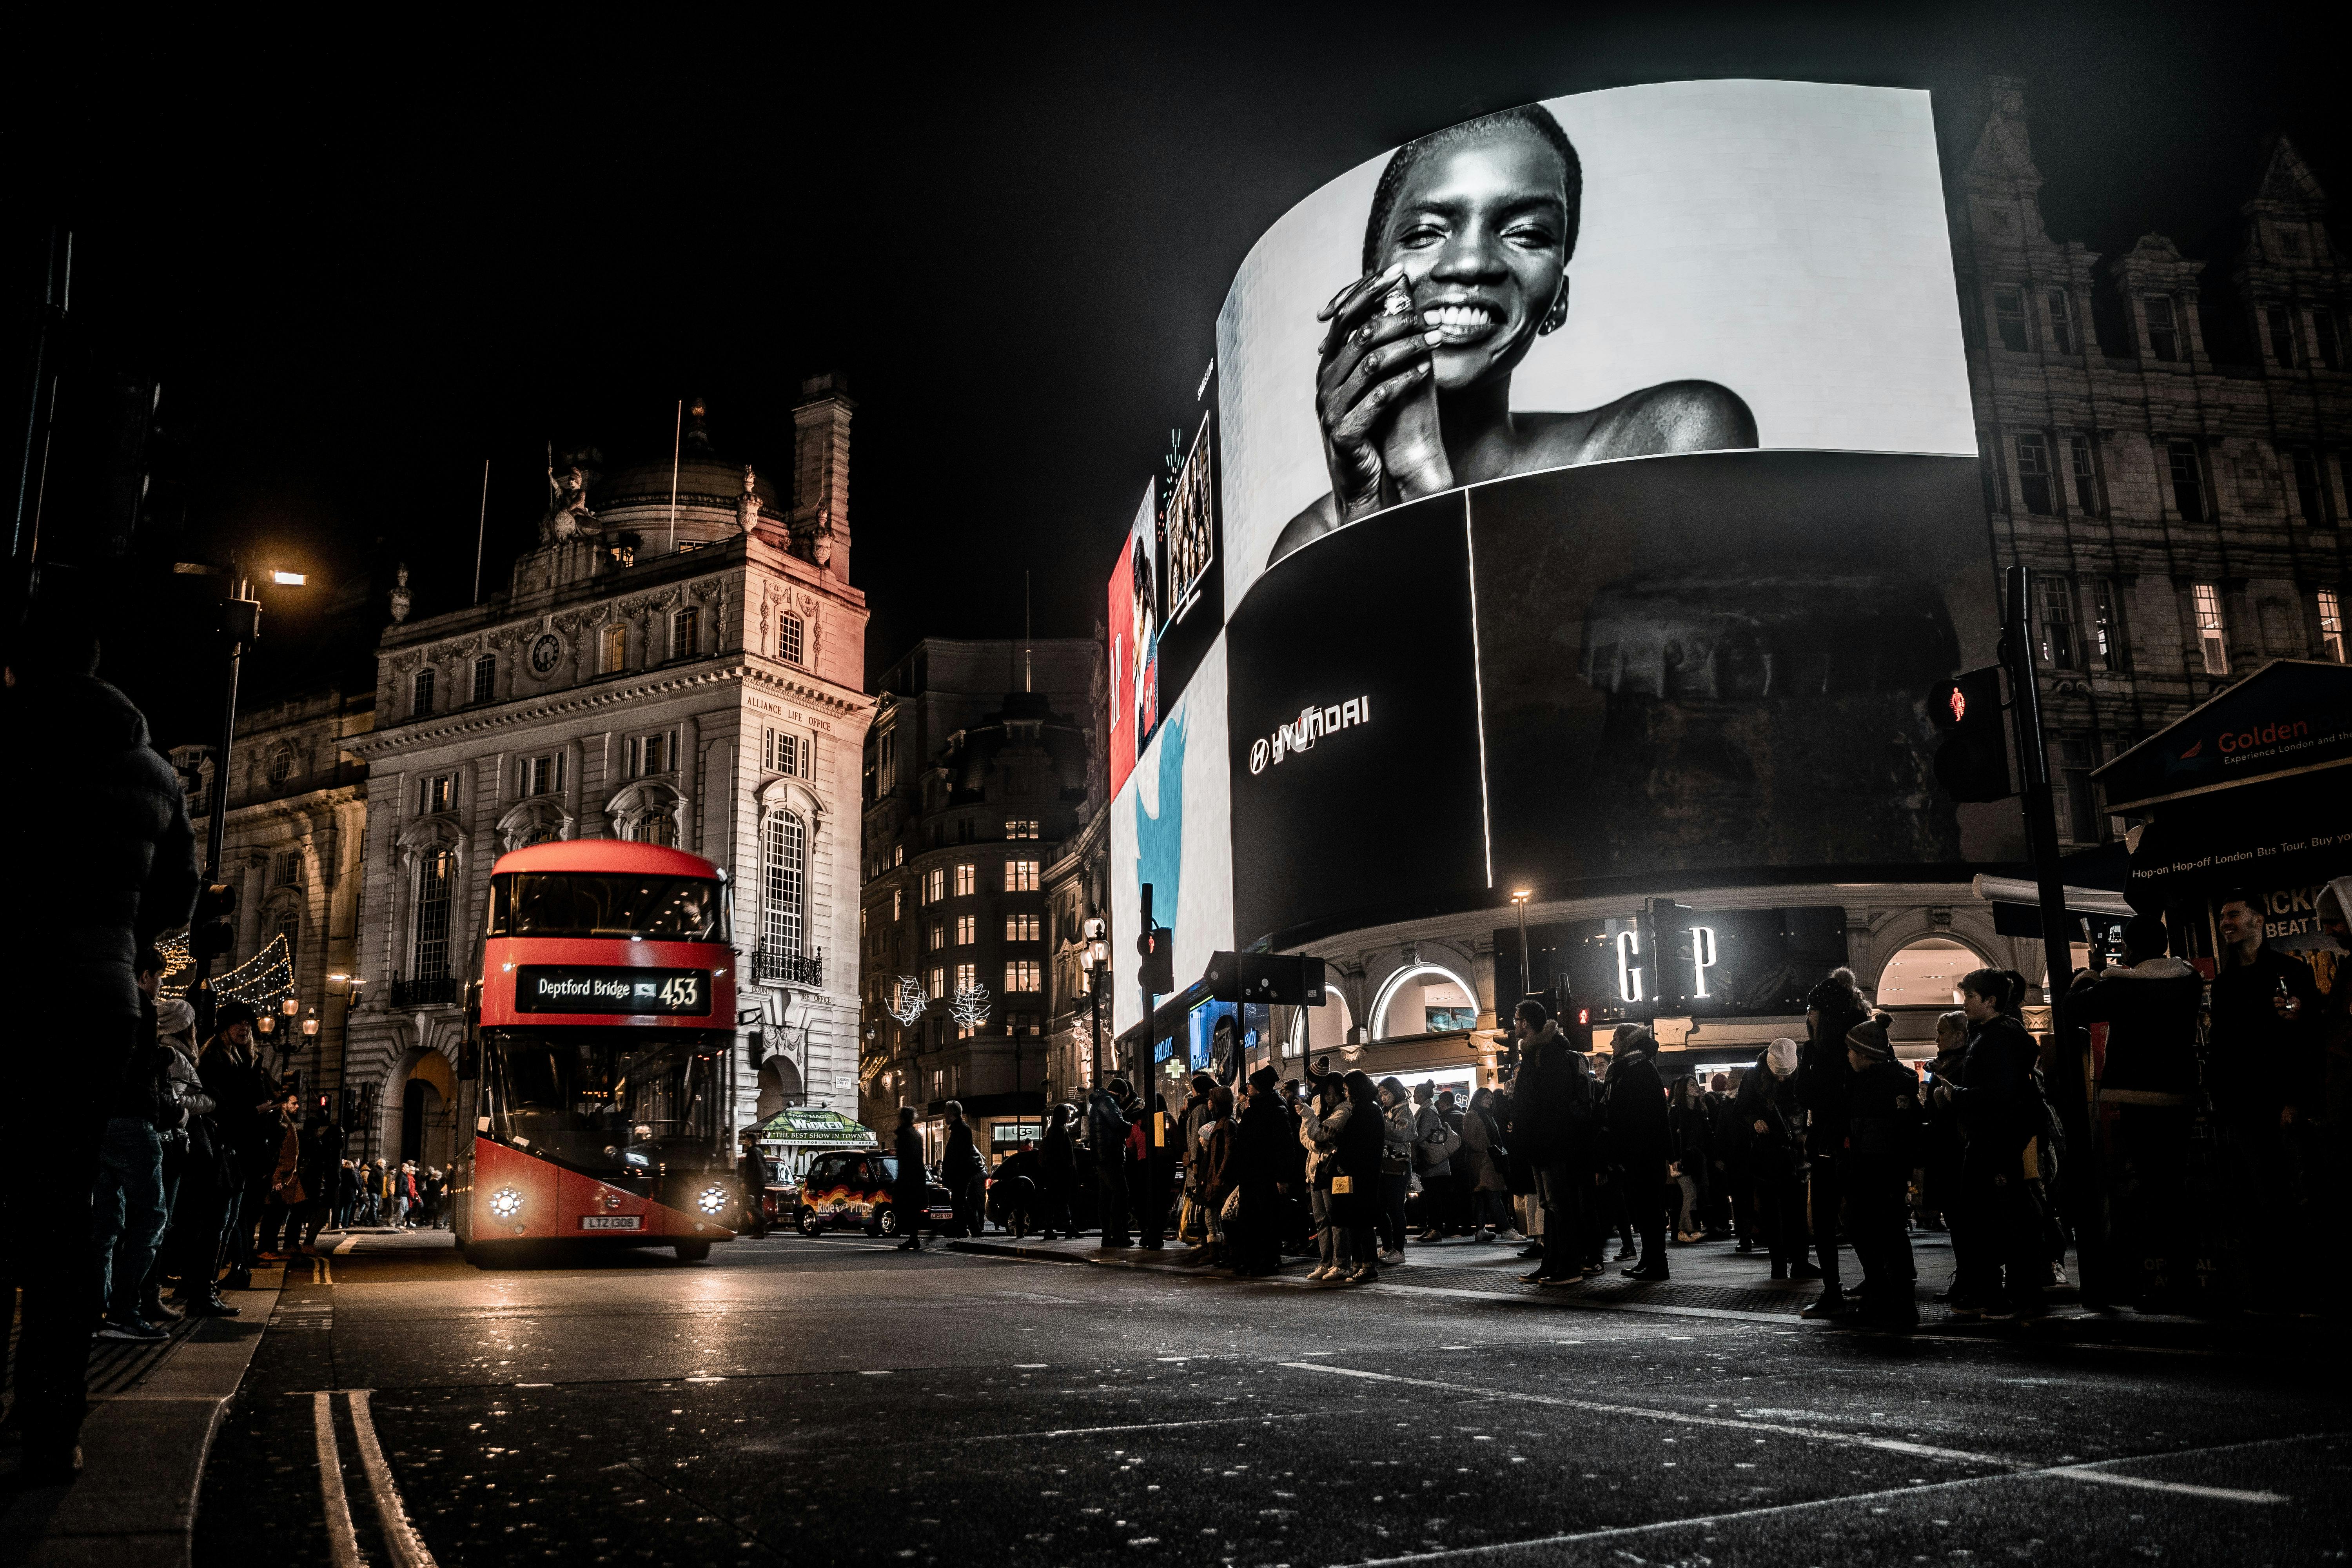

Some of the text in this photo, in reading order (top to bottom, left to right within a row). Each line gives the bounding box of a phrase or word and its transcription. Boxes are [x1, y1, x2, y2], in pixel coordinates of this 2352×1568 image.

[747, 696, 831, 731] ALLIANCE LIFE OFFICE
[1272, 695, 1368, 759] HYUNDAI
[2218, 720, 2308, 753] Golden
[2224, 748, 2275, 764] Experience
[2279, 739, 2314, 753] London
[2318, 734, 2335, 745] and
[2132, 866, 2169, 879] Hop-on
[2172, 857, 2211, 873] Hop-off
[2215, 850, 2253, 864] London
[2257, 846, 2277, 857] Bus
[2280, 841, 2307, 853] Tour,
[2312, 837, 2332, 847] Buy
[2265, 917, 2309, 938] BEAT
[1617, 926, 1717, 1003] GP
[539, 977, 698, 1005] Deptford Bridge 453
[751, 985, 775, 995] COUNTY
[814, 995, 831, 1003] OFFICE
[1191, 1052, 1209, 1072] pharmacy
[1012, 1127, 1033, 1136] UGG
[817, 1201, 835, 1213] Ride
[850, 1201, 873, 1213] Pride
